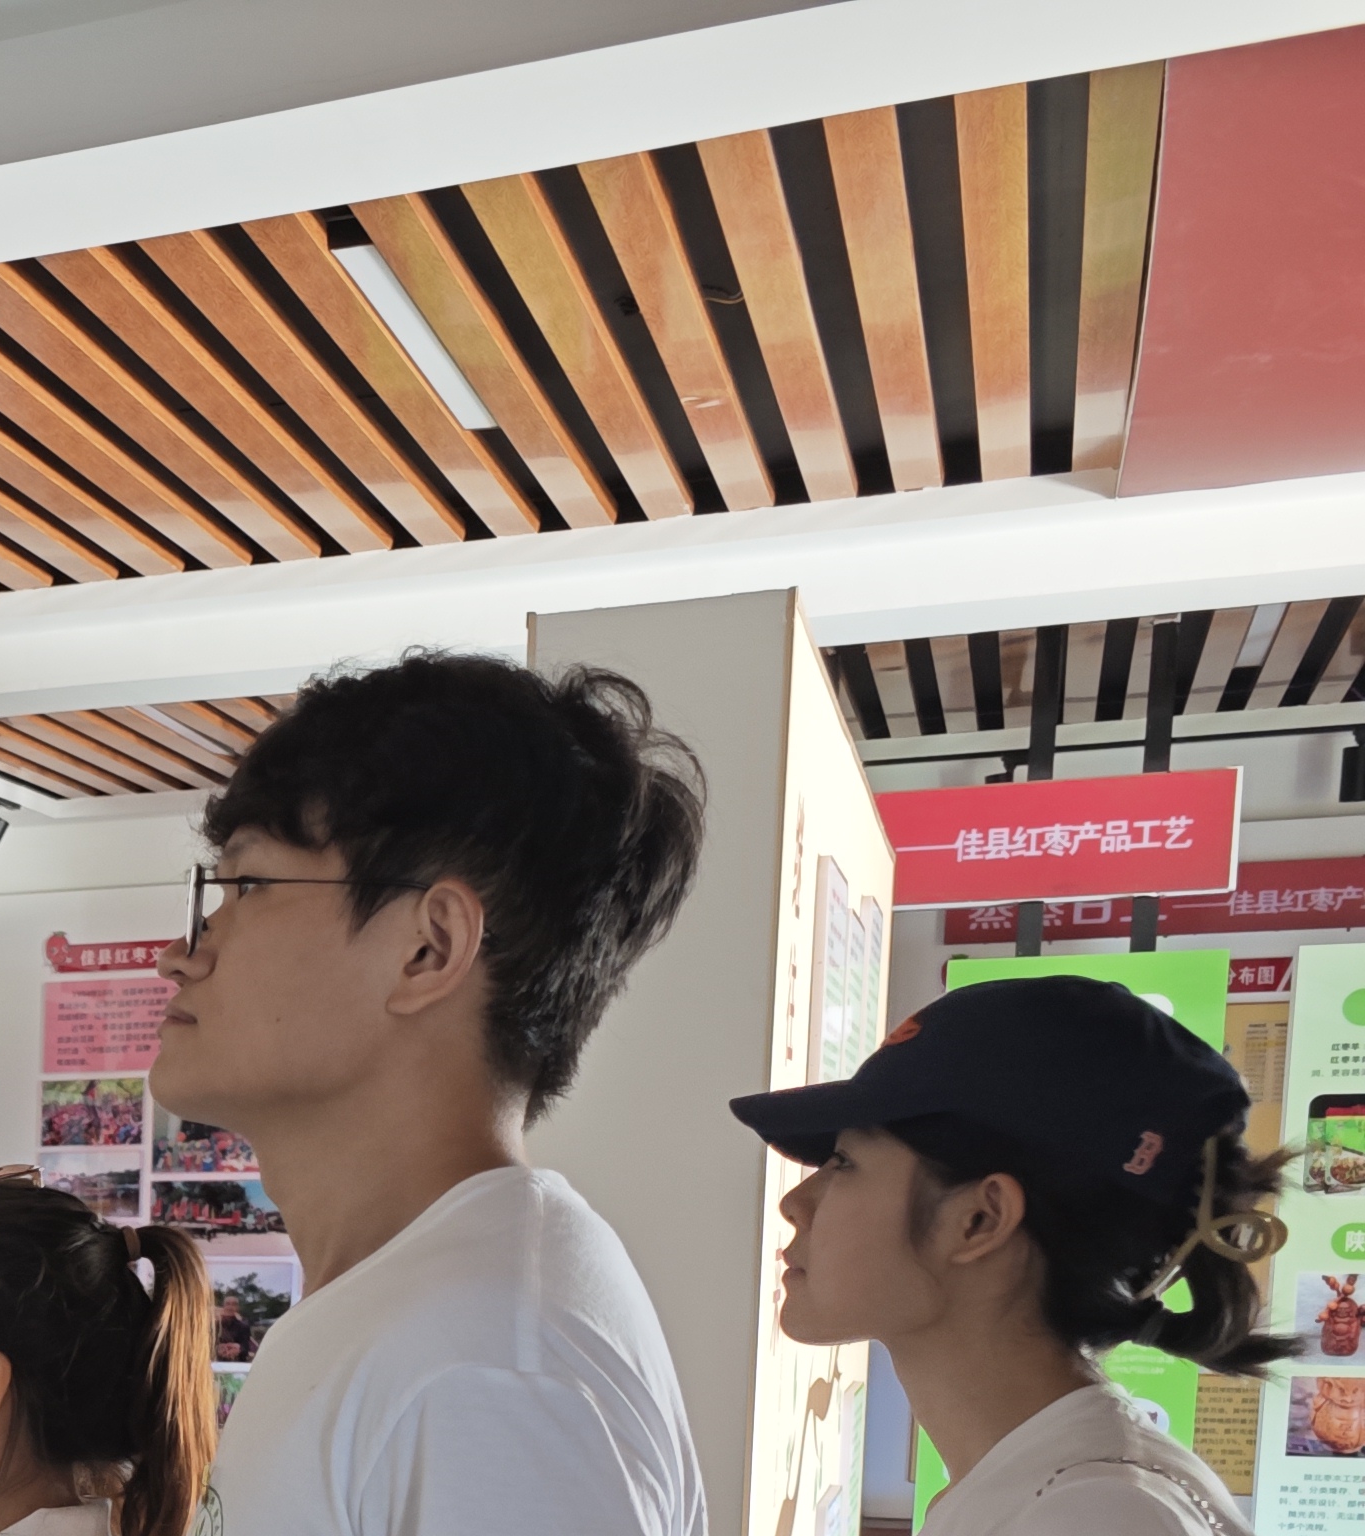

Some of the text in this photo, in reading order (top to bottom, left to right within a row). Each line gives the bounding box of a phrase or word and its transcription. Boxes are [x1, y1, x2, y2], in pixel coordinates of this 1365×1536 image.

[1172, 886, 1365, 917] ——佳县红枣产
[1123, 1130, 1164, 1176] B
